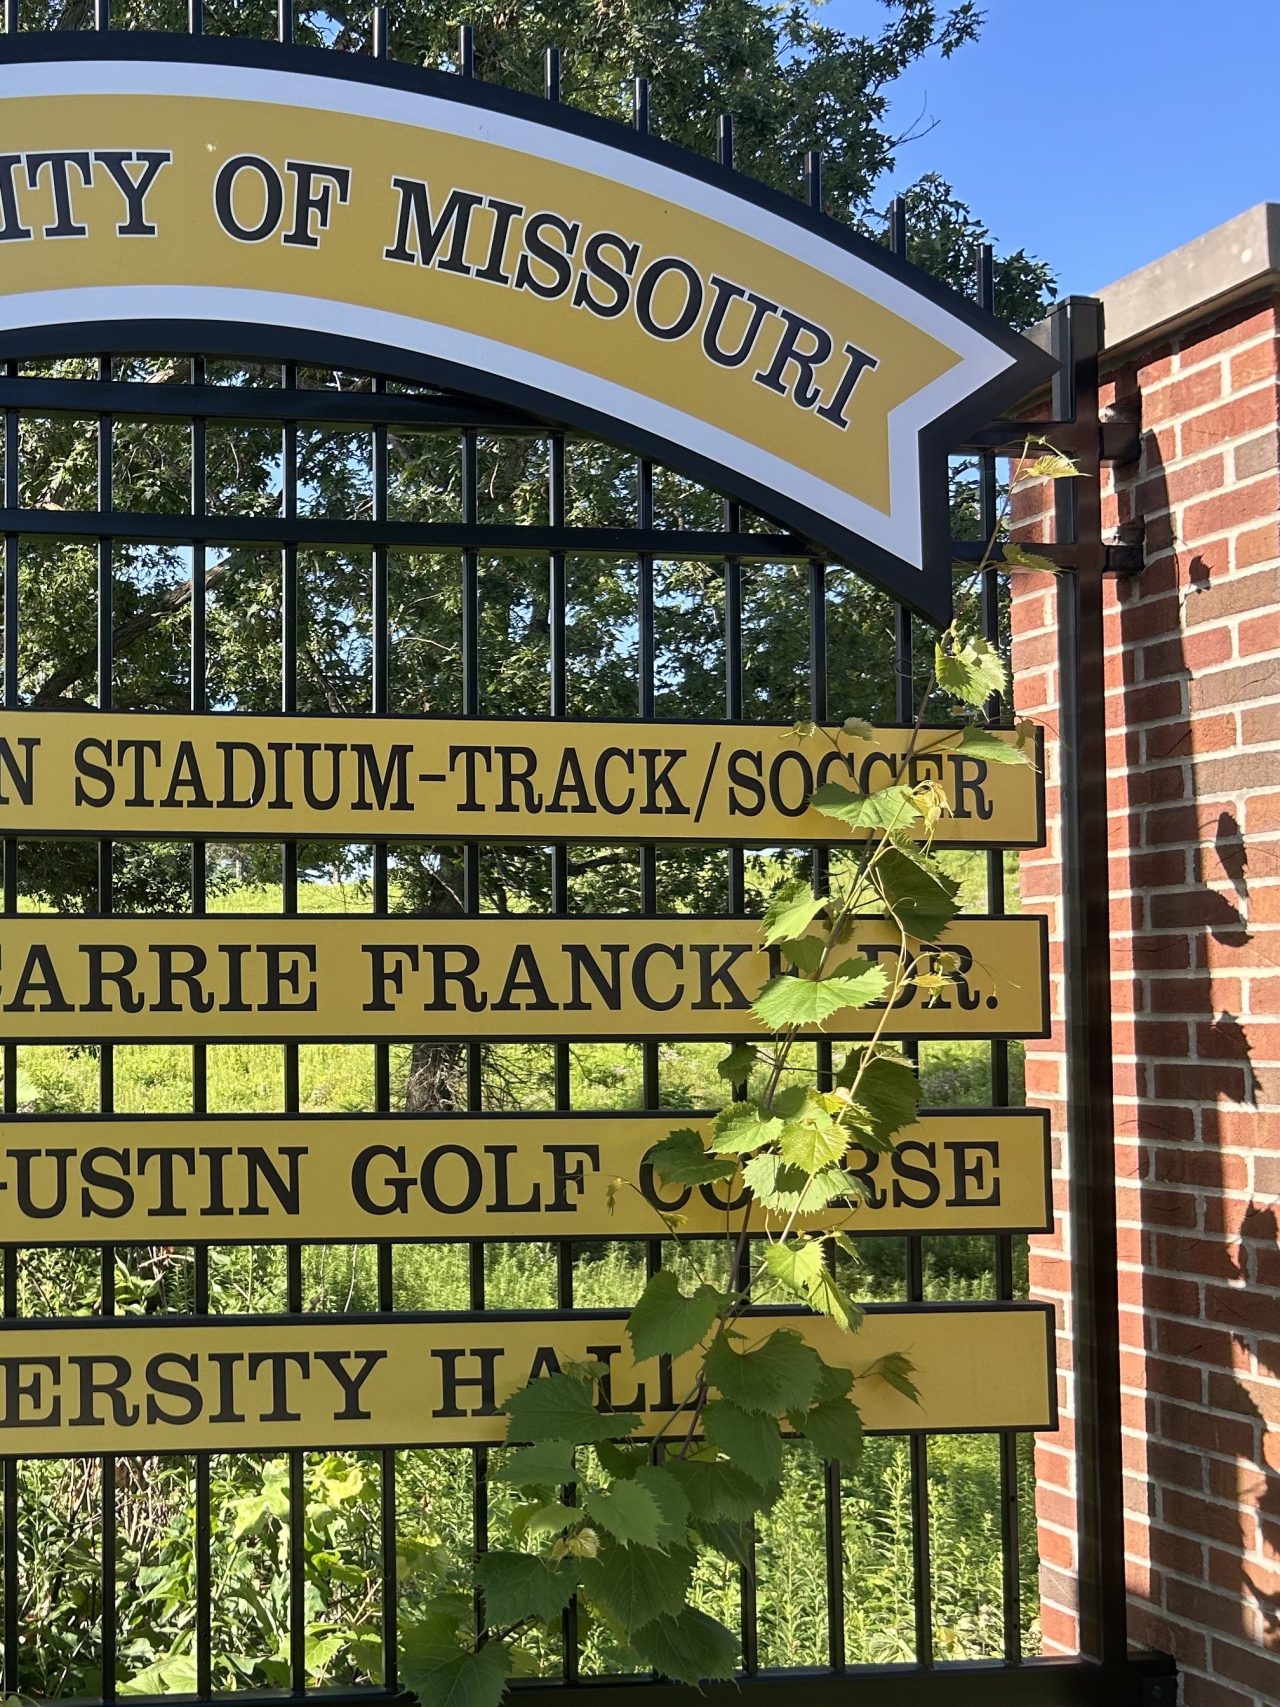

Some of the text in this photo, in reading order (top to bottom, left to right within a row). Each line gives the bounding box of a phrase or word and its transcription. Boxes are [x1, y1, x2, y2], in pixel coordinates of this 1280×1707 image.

[215, 155, 351, 248] OF
[384, 176, 879, 430] MISSOURI
[857, 944, 998, 1010] DR.
[352, 1145, 600, 1215] GOLF
[639, 1141, 1001, 1211] CORSE
